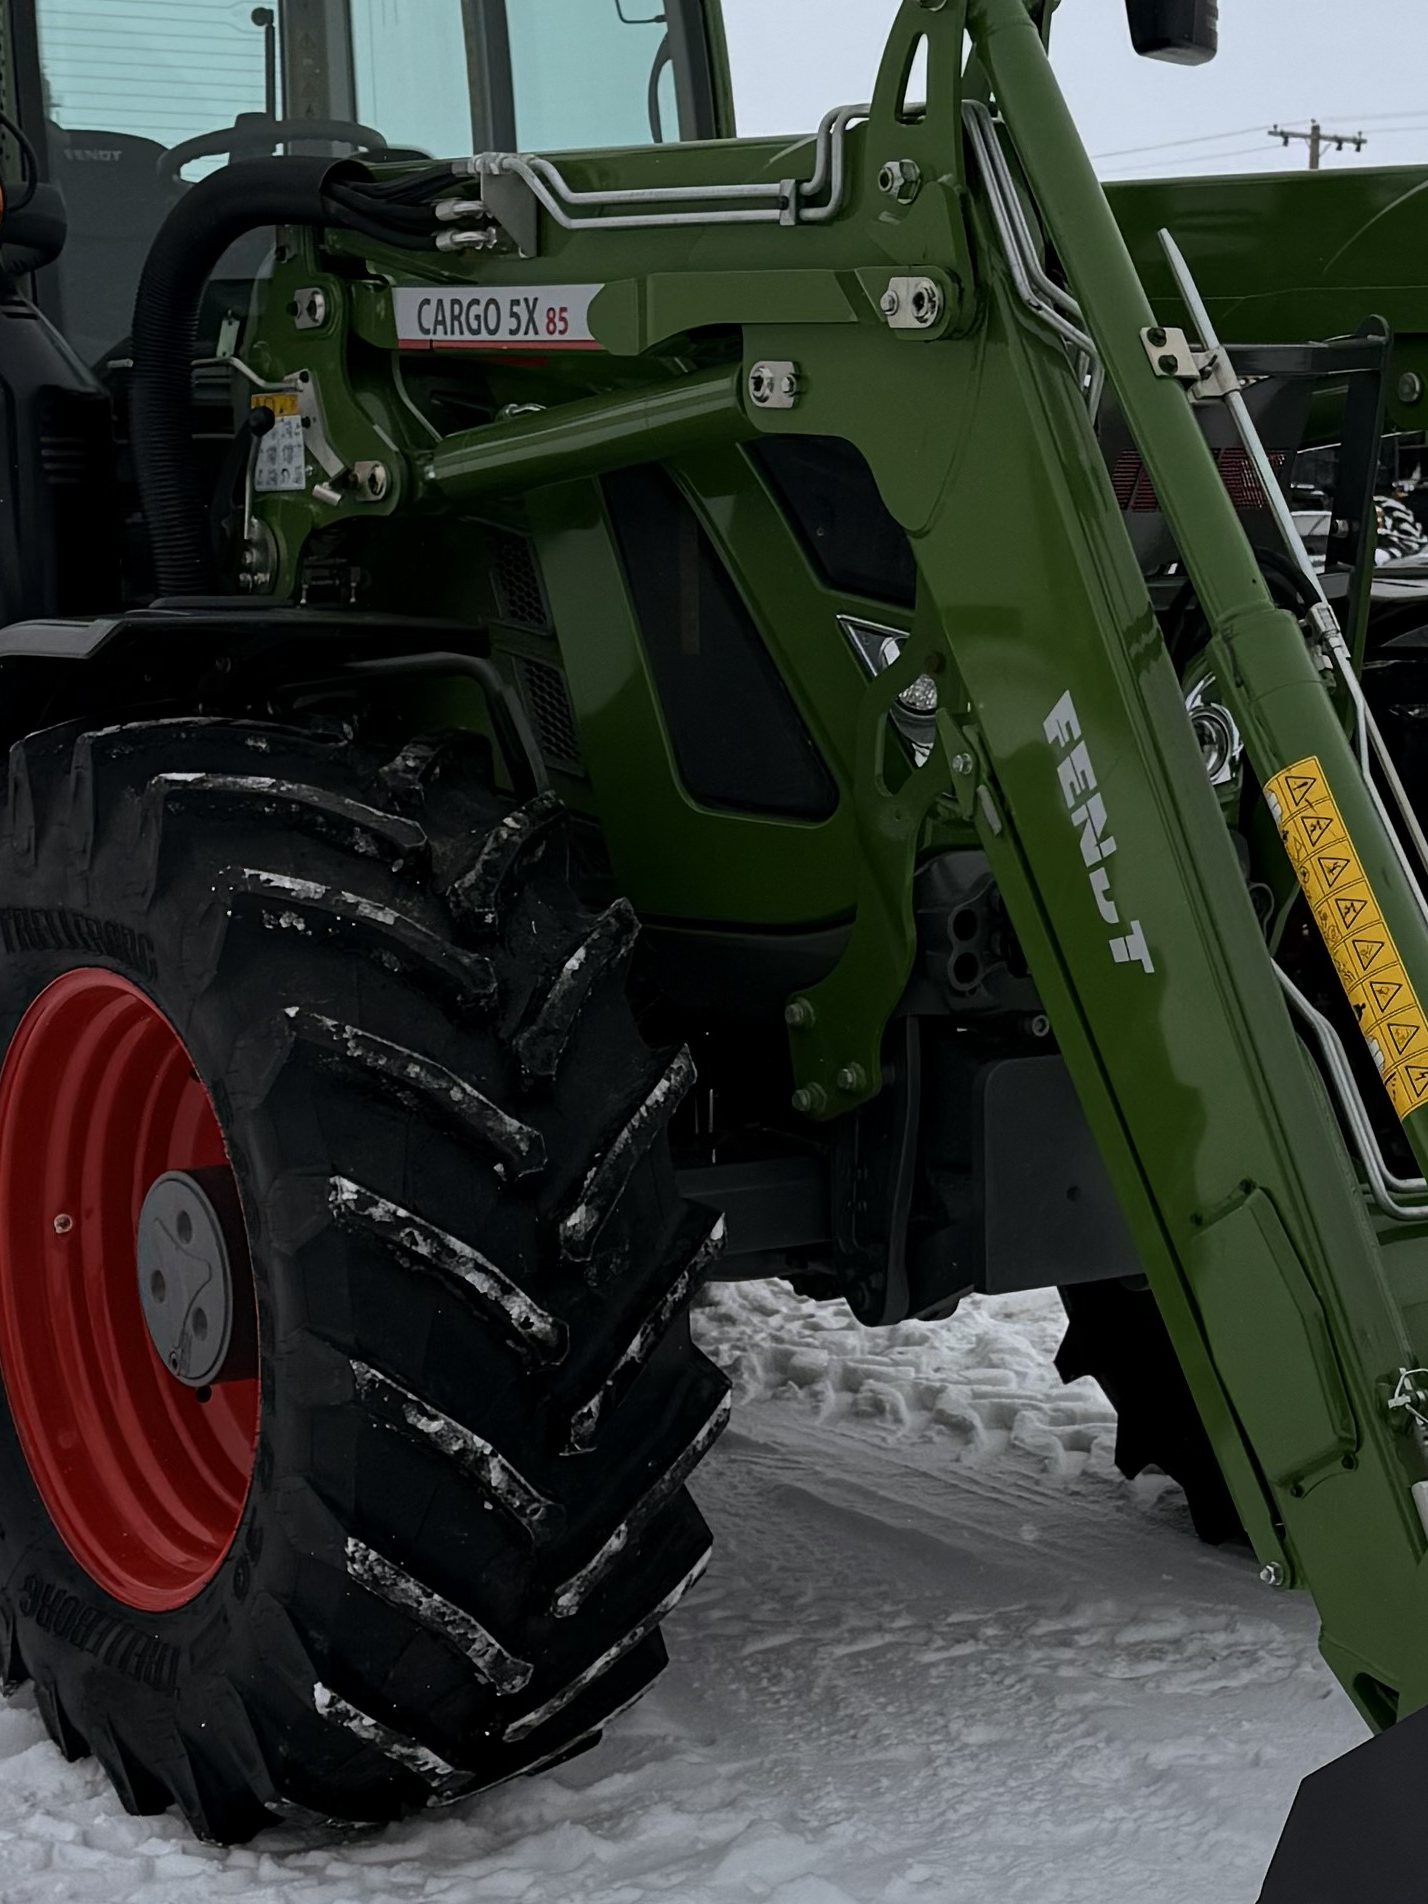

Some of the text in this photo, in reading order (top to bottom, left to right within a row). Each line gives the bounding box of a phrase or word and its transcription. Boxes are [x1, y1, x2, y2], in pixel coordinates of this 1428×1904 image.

[417, 297, 569, 336] CARGO 5X 85
[18, 1572, 182, 1699] TRELLEBORG
